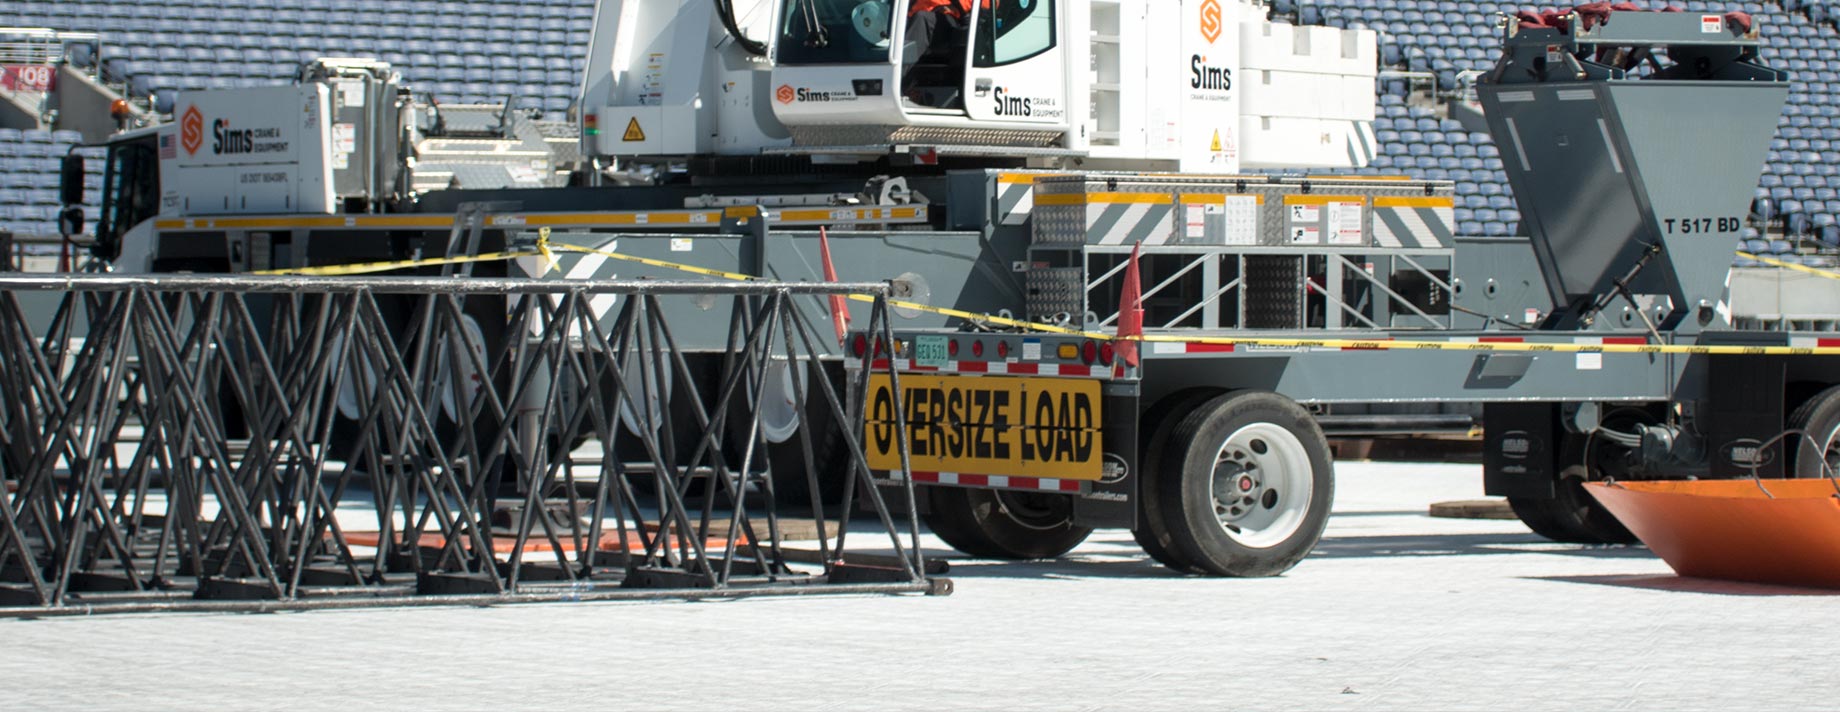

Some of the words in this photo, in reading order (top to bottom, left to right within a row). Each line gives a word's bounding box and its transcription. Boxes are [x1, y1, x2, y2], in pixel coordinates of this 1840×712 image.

[1191, 53, 1231, 91] Sims
[797, 86, 830, 102] Sims
[994, 86, 1031, 116] Sims
[1033, 97, 1051, 106] CRANE
[1033, 109, 1064, 118] EQUIPMENT
[213, 117, 254, 155] Sims
[254, 127, 275, 138] CRANE
[254, 141, 289, 153] EQUIPMENT
[1664, 218, 1676, 235] T
[1681, 218, 1712, 234] 517
[1717, 217, 1740, 233] BD
[1352, 341, 1380, 349] CAUTION
[1020, 390, 1093, 463] LOAD
